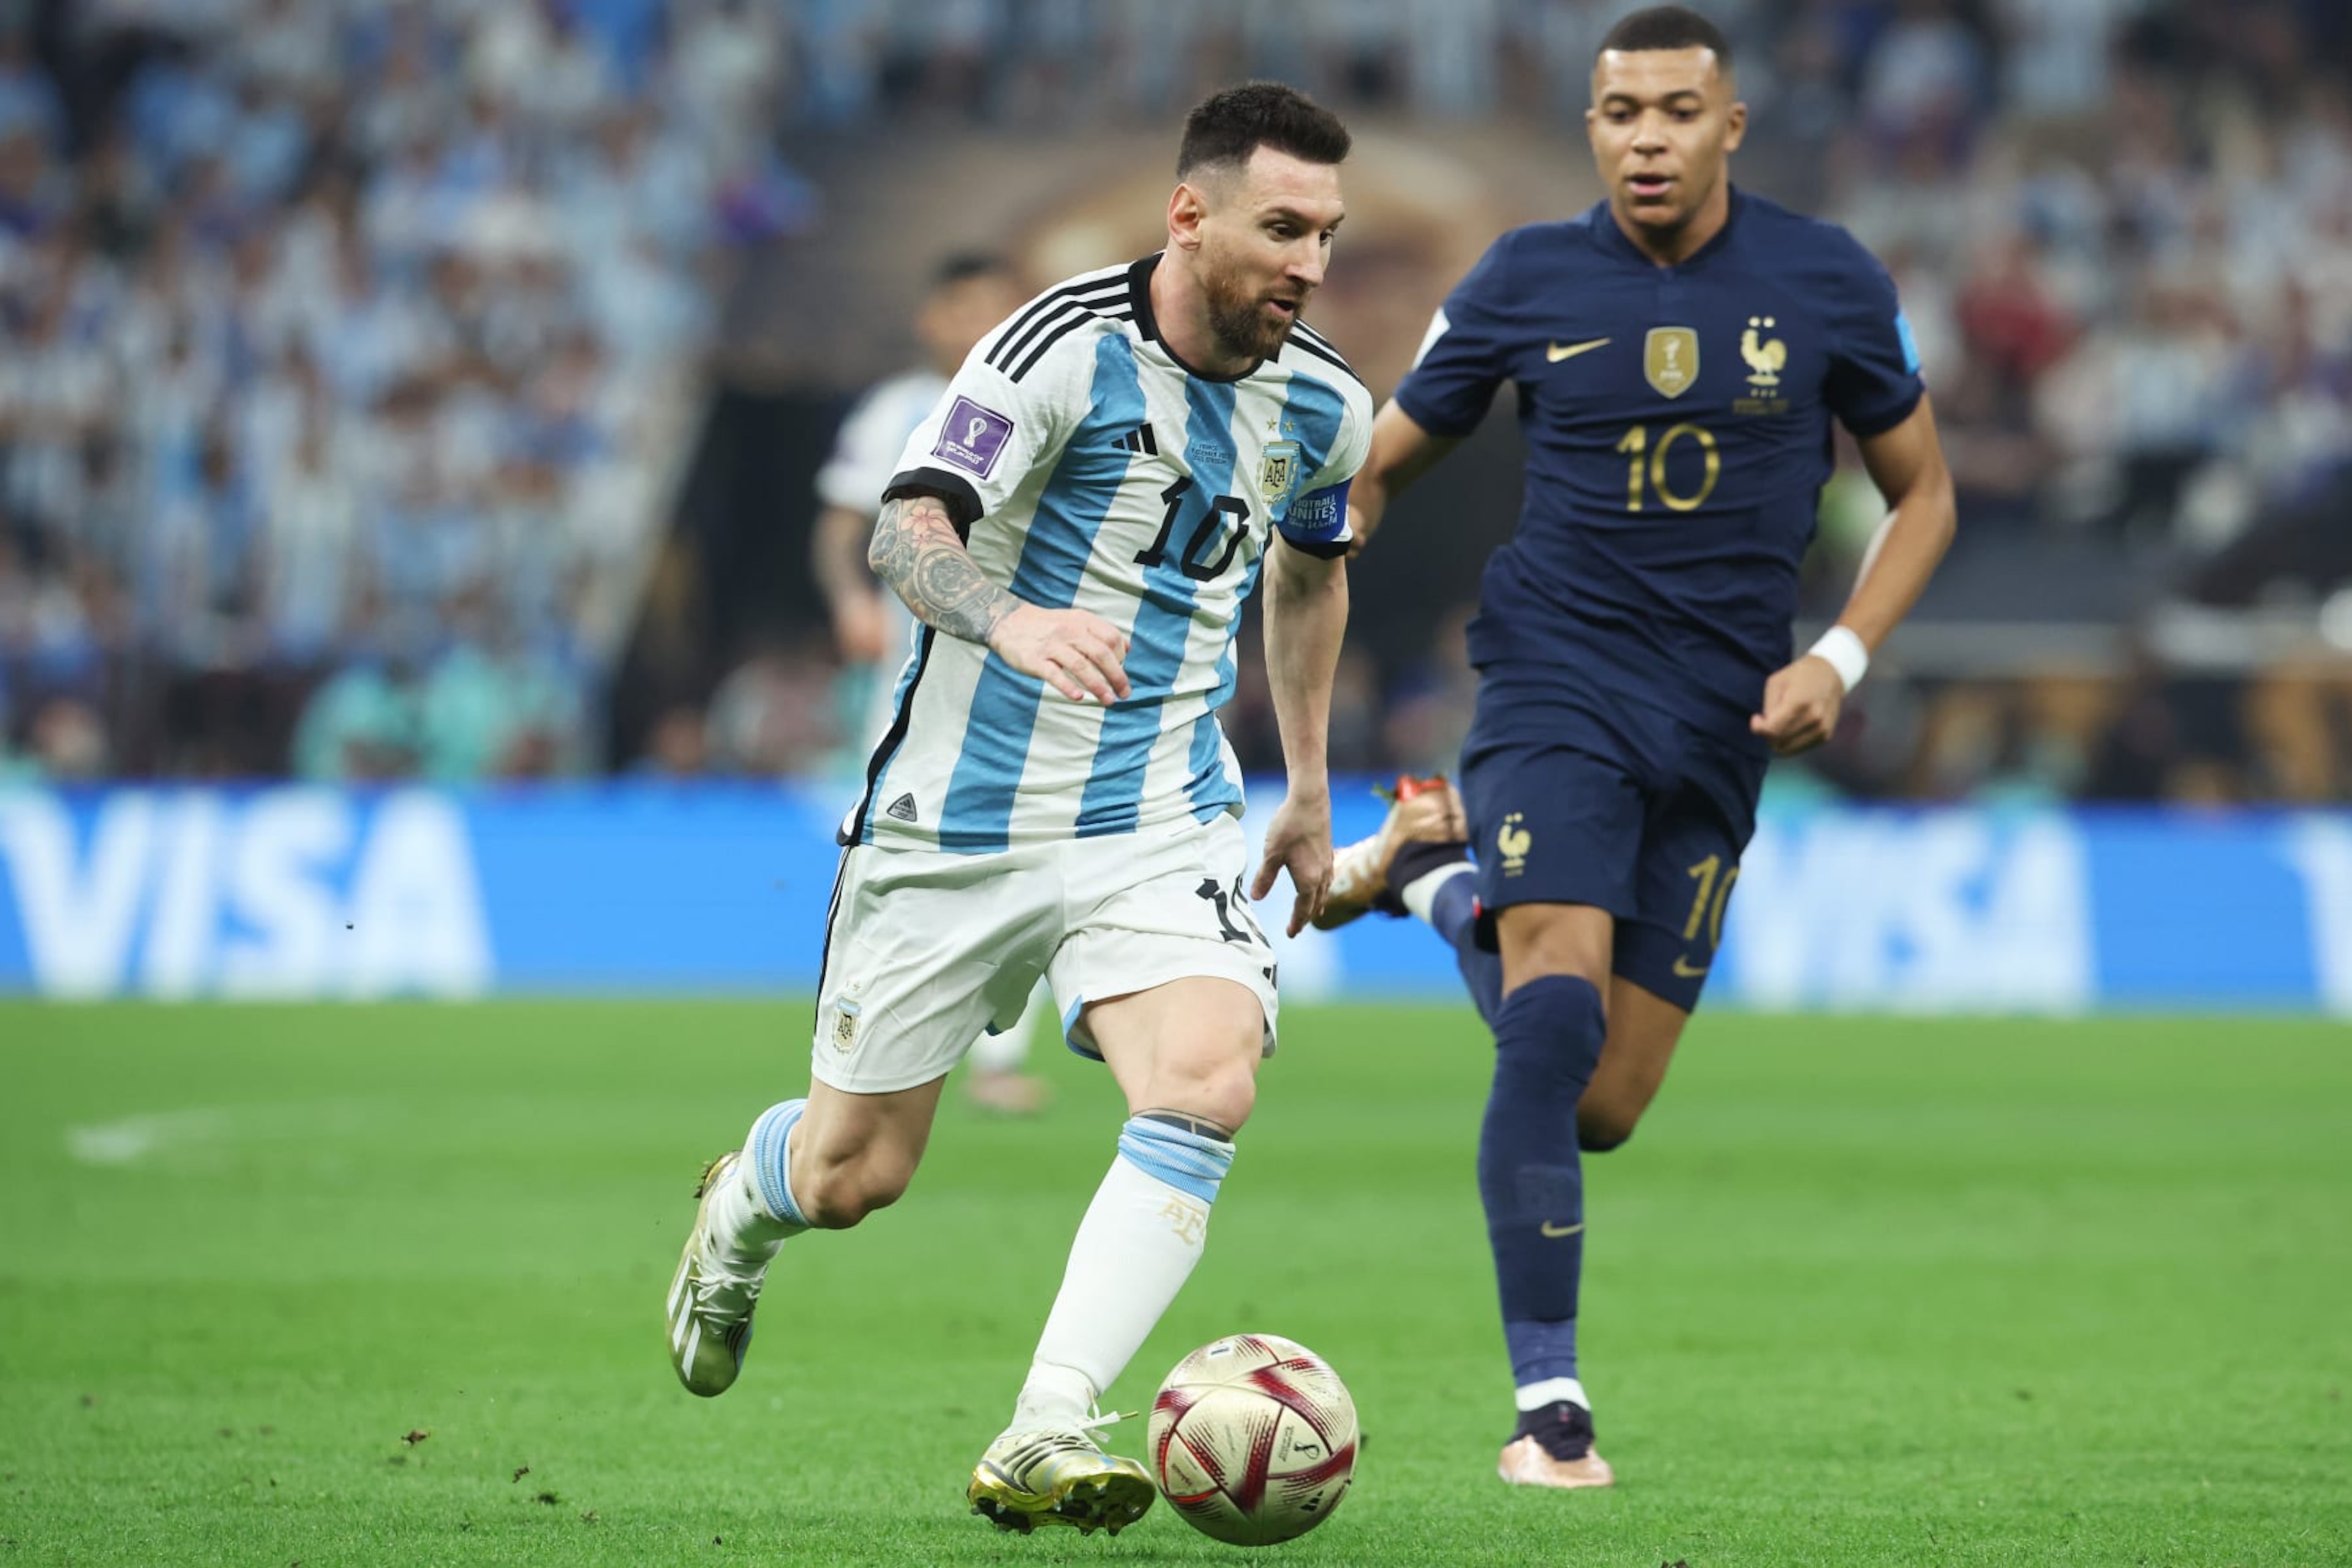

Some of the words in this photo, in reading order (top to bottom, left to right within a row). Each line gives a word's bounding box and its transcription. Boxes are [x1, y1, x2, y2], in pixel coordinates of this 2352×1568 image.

[1288, 502, 1336, 521] UNITES
[1615, 422, 1721, 513] 10
[1133, 476, 1250, 582] 10
[0, 789, 492, 1005] VISA
